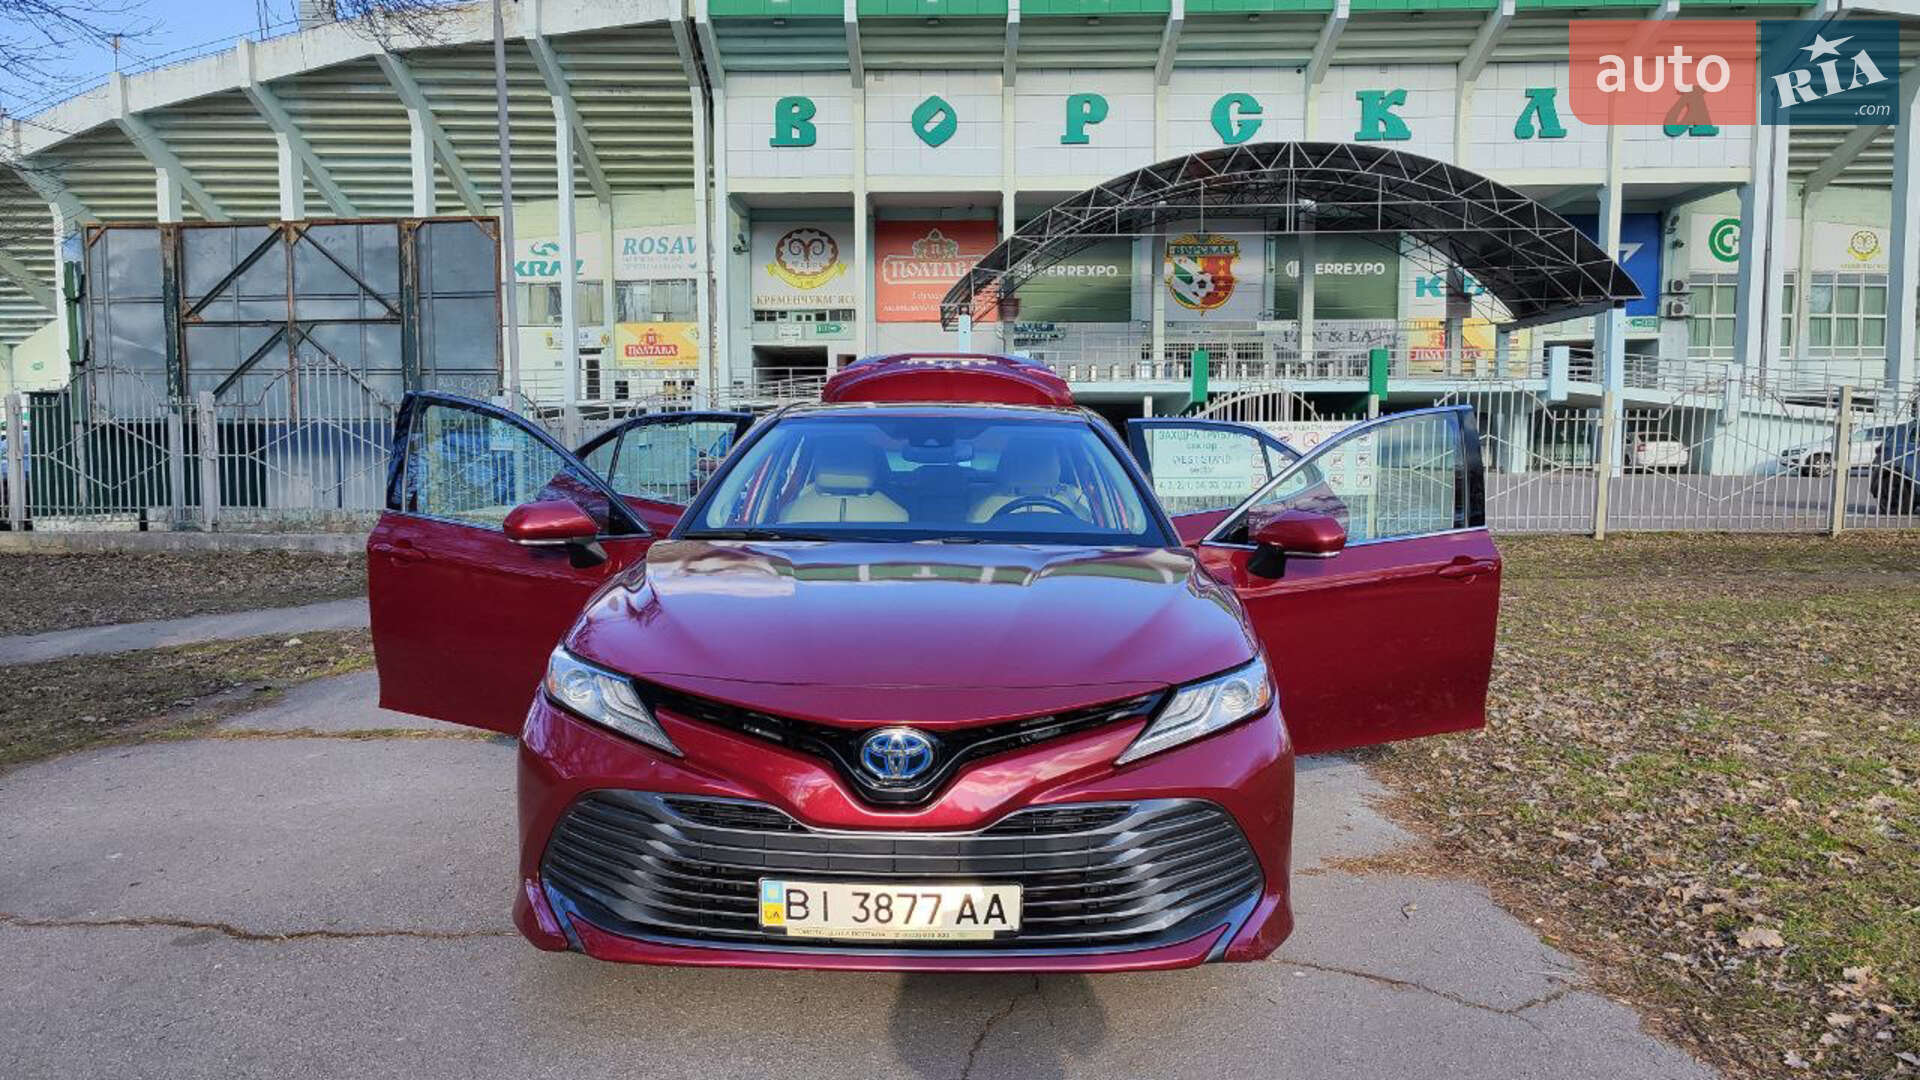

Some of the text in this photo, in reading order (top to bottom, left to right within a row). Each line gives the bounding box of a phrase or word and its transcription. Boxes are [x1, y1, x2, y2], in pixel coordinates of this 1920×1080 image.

[623, 236, 697, 256] ROSAV
[890, 260, 977, 279] ПОЛТАВ
[1040, 264, 1119, 278] ERREXPO
[785, 888, 1008, 925] BI 3877 AA
